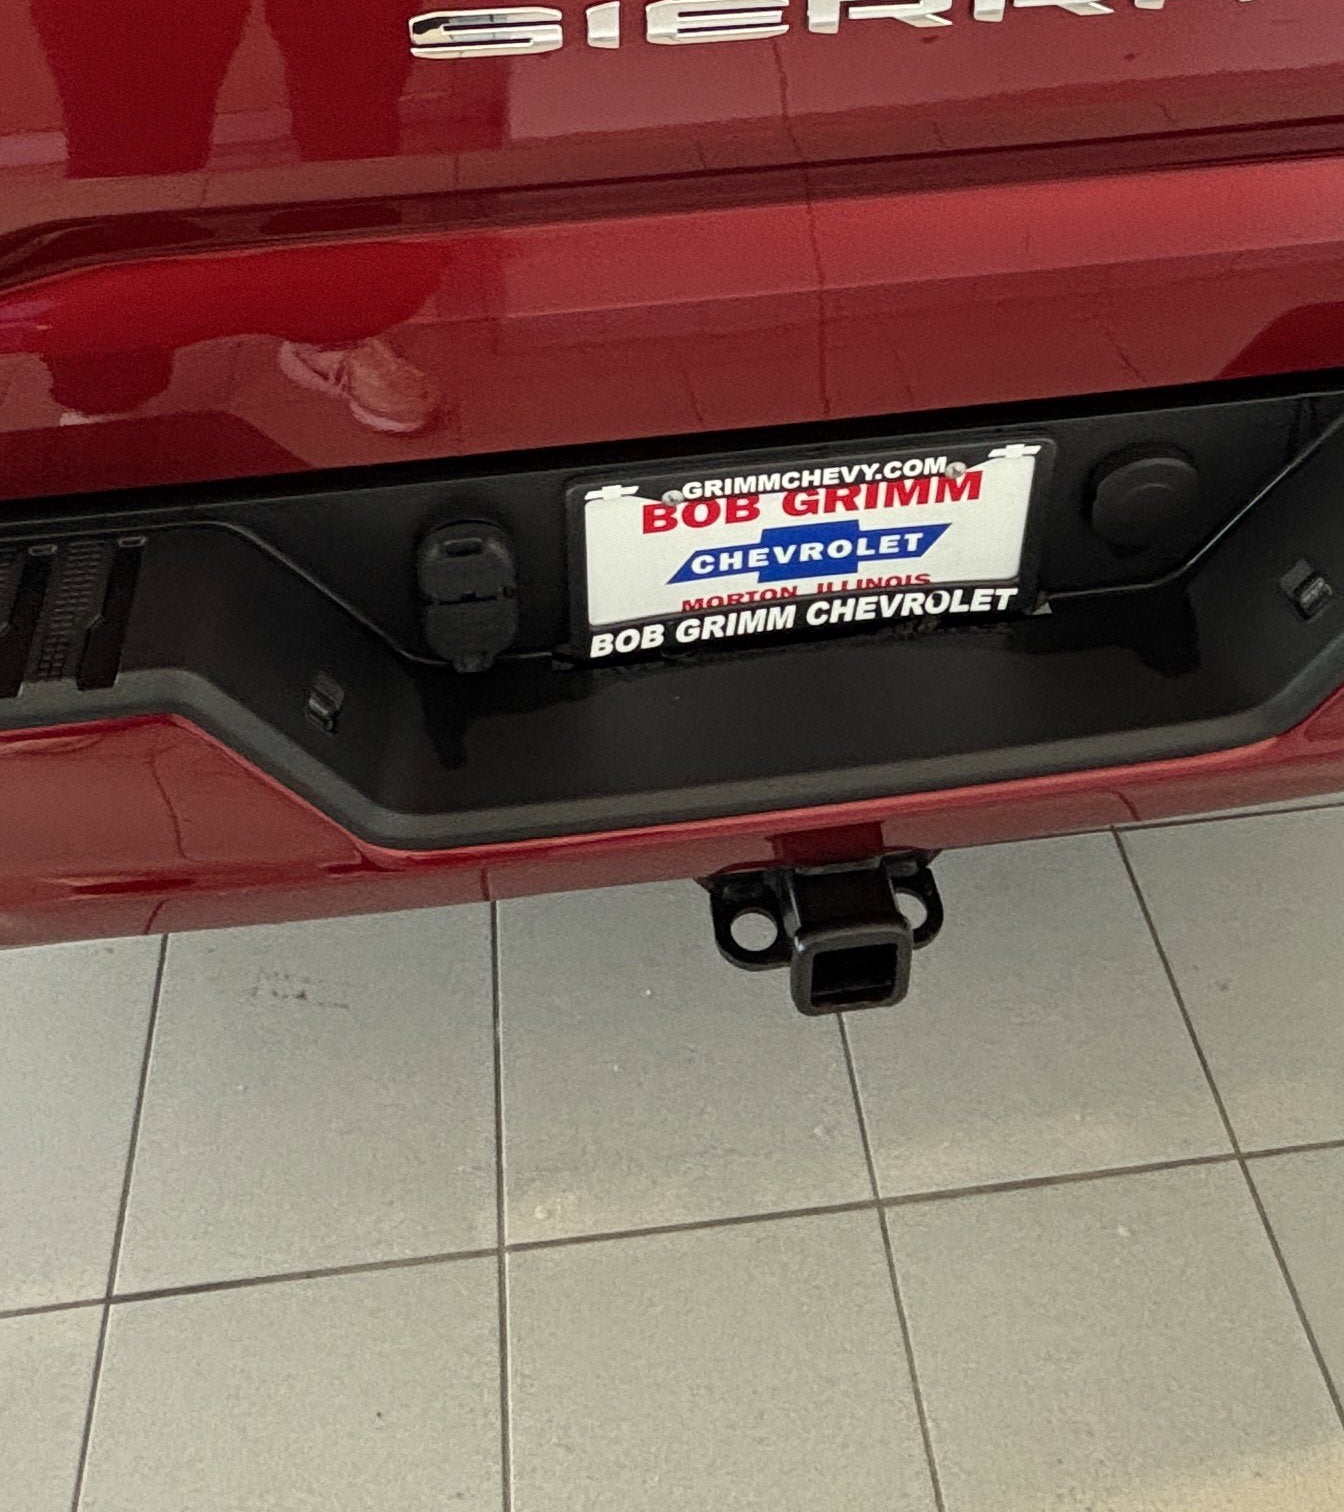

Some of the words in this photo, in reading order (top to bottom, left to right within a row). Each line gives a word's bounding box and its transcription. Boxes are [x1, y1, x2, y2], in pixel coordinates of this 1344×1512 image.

[682, 455, 948, 500] GRIMMCHEVY.COM
[642, 494, 761, 535] BOB
[781, 469, 984, 517] GRIMM
[689, 532, 924, 576] CHEVROLET
[681, 585, 798, 613] MORTON
[590, 624, 665, 658] BOB
[675, 603, 795, 644] GRIMM
[806, 587, 1019, 627] CHEVROLET
